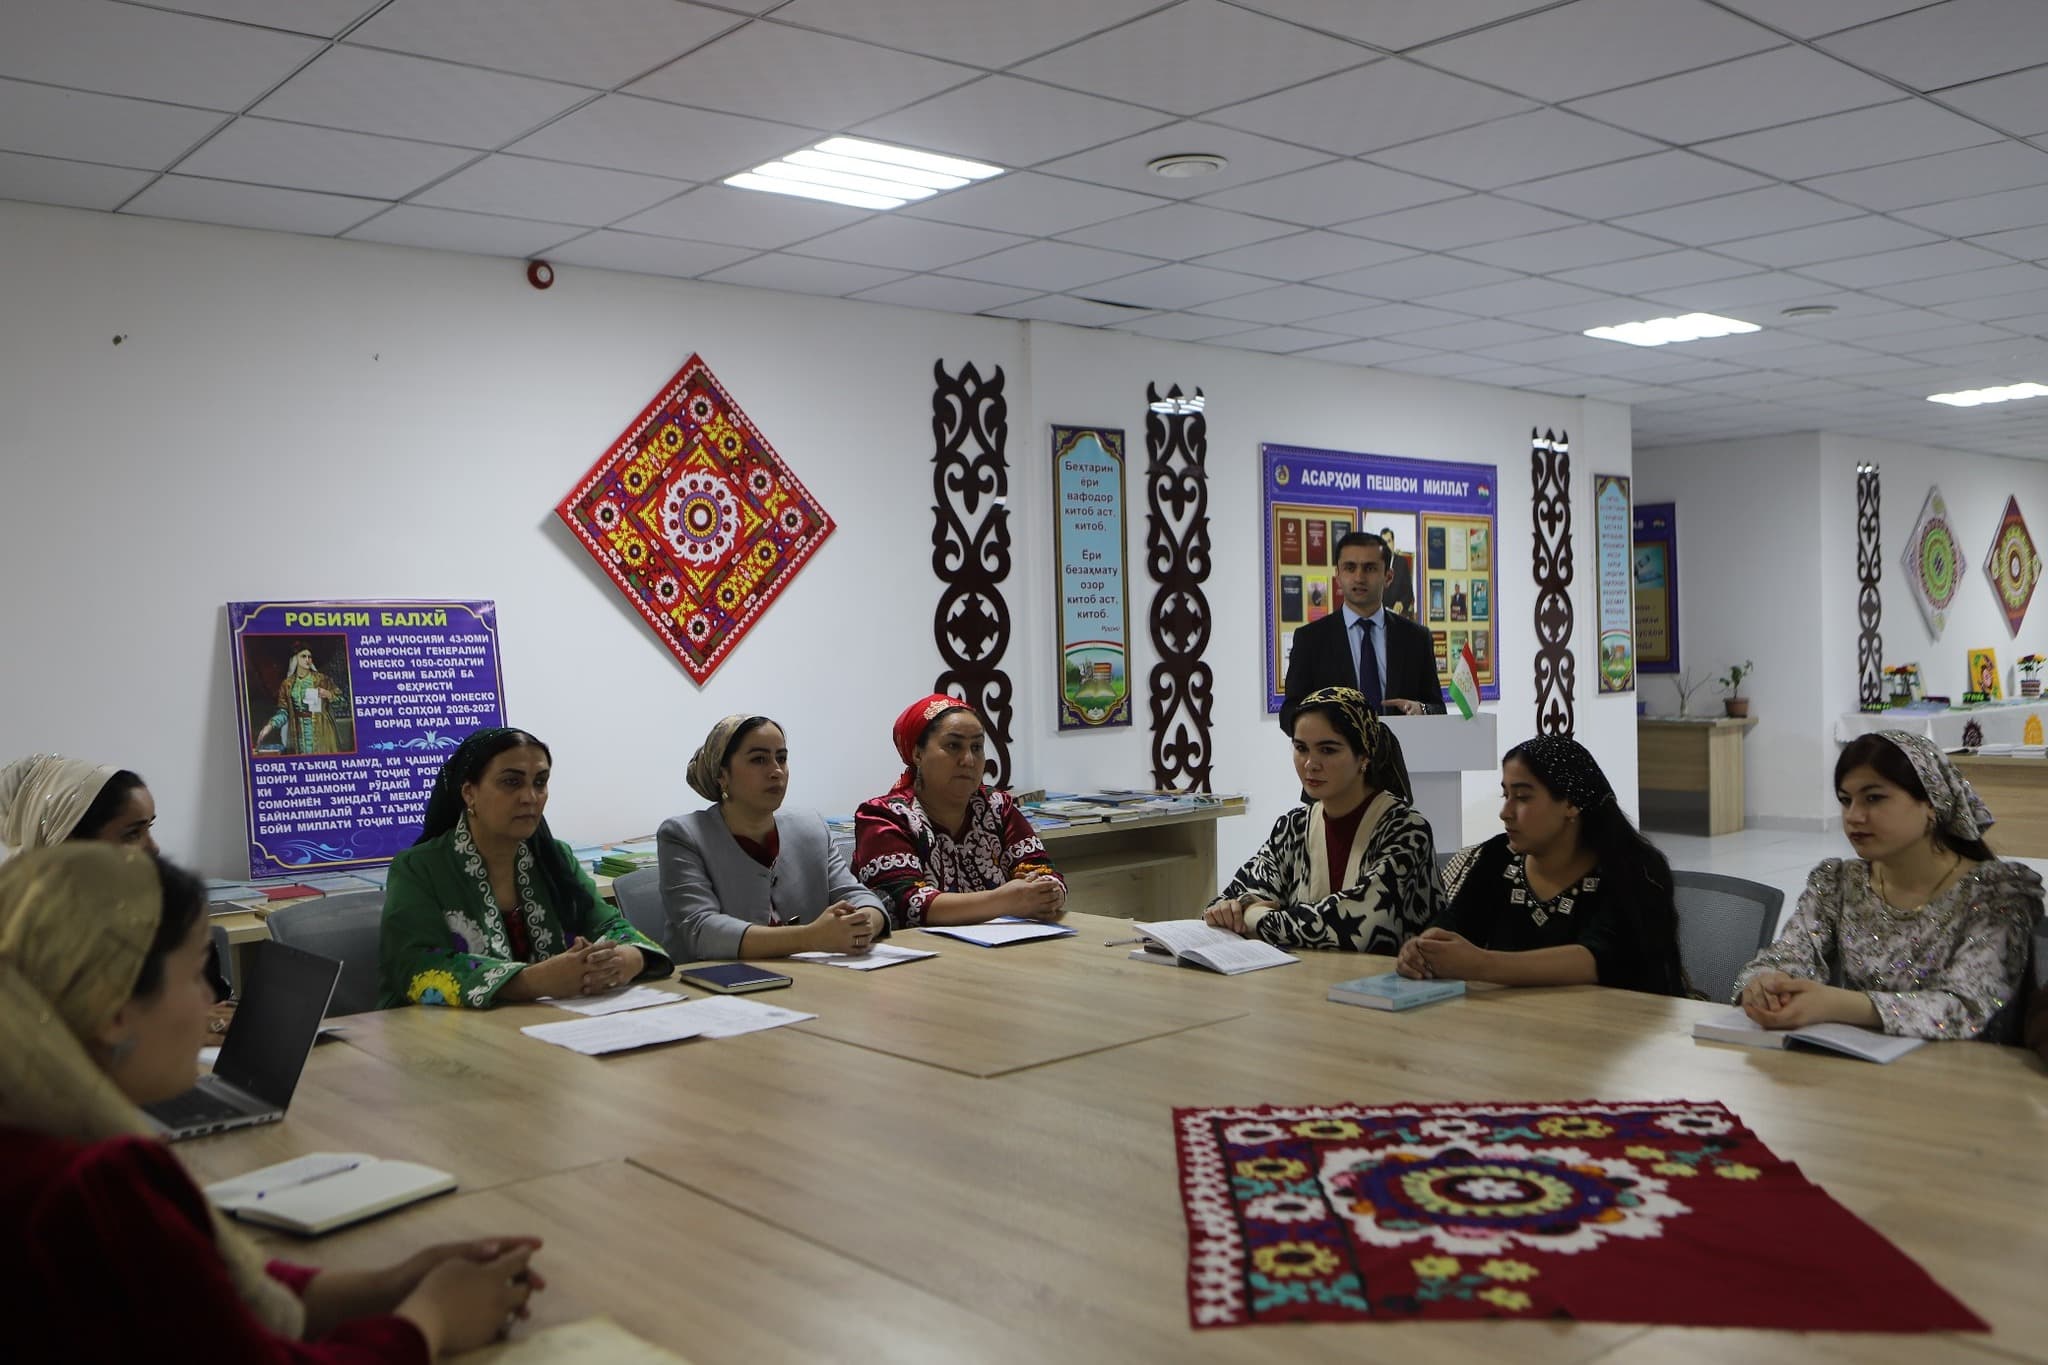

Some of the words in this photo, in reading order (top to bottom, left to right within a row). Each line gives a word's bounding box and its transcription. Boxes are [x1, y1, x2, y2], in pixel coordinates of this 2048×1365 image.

[1065, 460, 1114, 474] Беҳтарин
[1301, 469, 1361, 491] АСАРҲОИ
[1366, 474, 1418, 493] ПЕШВОИ
[1423, 478, 1470, 497] МИЛЛАТ
[1065, 506, 1094, 517] китоб
[1082, 549, 1102, 562] Ёри
[1066, 564, 1118, 577] безаҳмату
[1080, 580, 1105, 592] озор
[1067, 594, 1096, 605] китоб
[285, 612, 370, 627] РОБИЯИ
[381, 609, 448, 627] БАЛХӢ
[360, 635, 382, 645] ДАР
[387, 634, 445, 646] ИҶЛОСИЯИ
[449, 633, 489, 644] 43-ЮМИ
[355, 646, 421, 656] КОНФРОНСИ
[426, 645, 486, 656] ГЕНЕРАЛИИ
[359, 658, 405, 668] ЮНЕСКО
[410, 657, 485, 668] 1050-СОЛАГИИ
[372, 670, 416, 680] РОБИЯИ
[460, 669, 475, 679] БА
[397, 681, 453, 693] ФЕҲРИСТИ
[355, 693, 446, 706] БУЗУРГДОШТҲОИ
[451, 692, 495, 702] ЮНЕСКО
[356, 707, 394, 717] БАРОИ
[398, 705, 442, 718] СОЛҲОИ
[446, 703, 496, 714] 2026-2027
[374, 718, 412, 729] ВОРИД
[416, 717, 452, 728] КАРДА
[455, 715, 481, 727] ШУД.
[255, 763, 286, 774] БОЯД
[290, 760, 337, 772] ТАЪКИД
[341, 758, 382, 770] НАМУД,
[386, 756, 401, 766] КИ
[405, 754, 444, 766] ҶАШНИ
[256, 774, 297, 785] ШОИРИ
[305, 771, 368, 783] ШИНОХТАИ
[374, 768, 411, 780] ТОҶИК
[417, 765, 441, 776] РОБ
[257, 788, 272, 798] КИ
[286, 783, 356, 797] ҲАМЗАМОНИ
[258, 796, 322, 810] СОМОНИЁН
[330, 792, 381, 807] ЗИНДАГӢ
[259, 805, 352, 823] БАЙНАЛМИЛАЛӢ
[360, 805, 374, 816] АЗ
[260, 822, 292, 835] БОЙИ
[297, 820, 352, 833] МИЛЛАТИ
[357, 817, 393, 830] ТОҶИК
